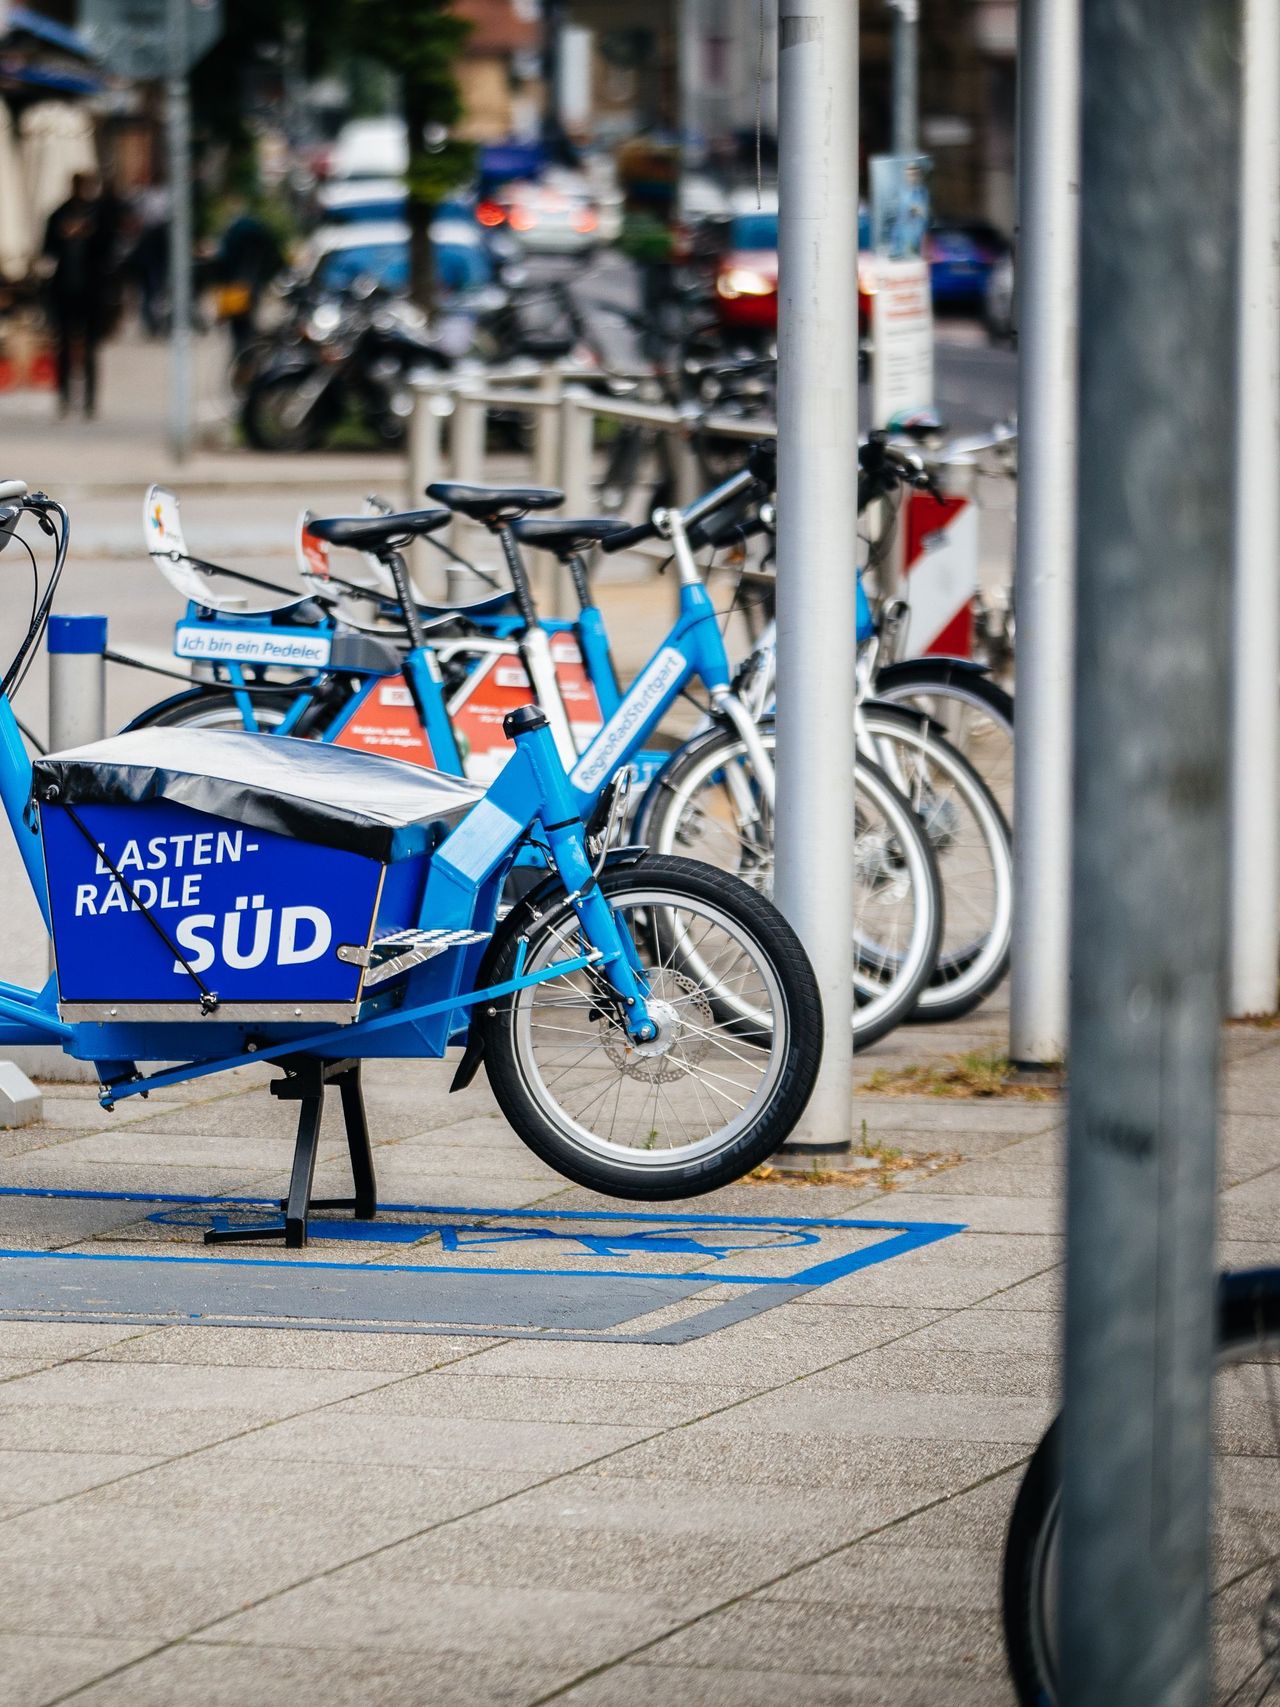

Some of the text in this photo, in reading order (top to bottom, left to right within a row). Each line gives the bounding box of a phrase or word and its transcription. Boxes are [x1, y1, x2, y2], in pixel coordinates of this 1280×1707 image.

[183, 636, 321, 660] Ich bin ein Pedelec
[580, 656, 679, 786] RegioRadStuttgart
[95, 830, 259, 875] LASTEN-
[75, 873, 202, 916] RÄDLE
[173, 895, 332, 974] SÜD
